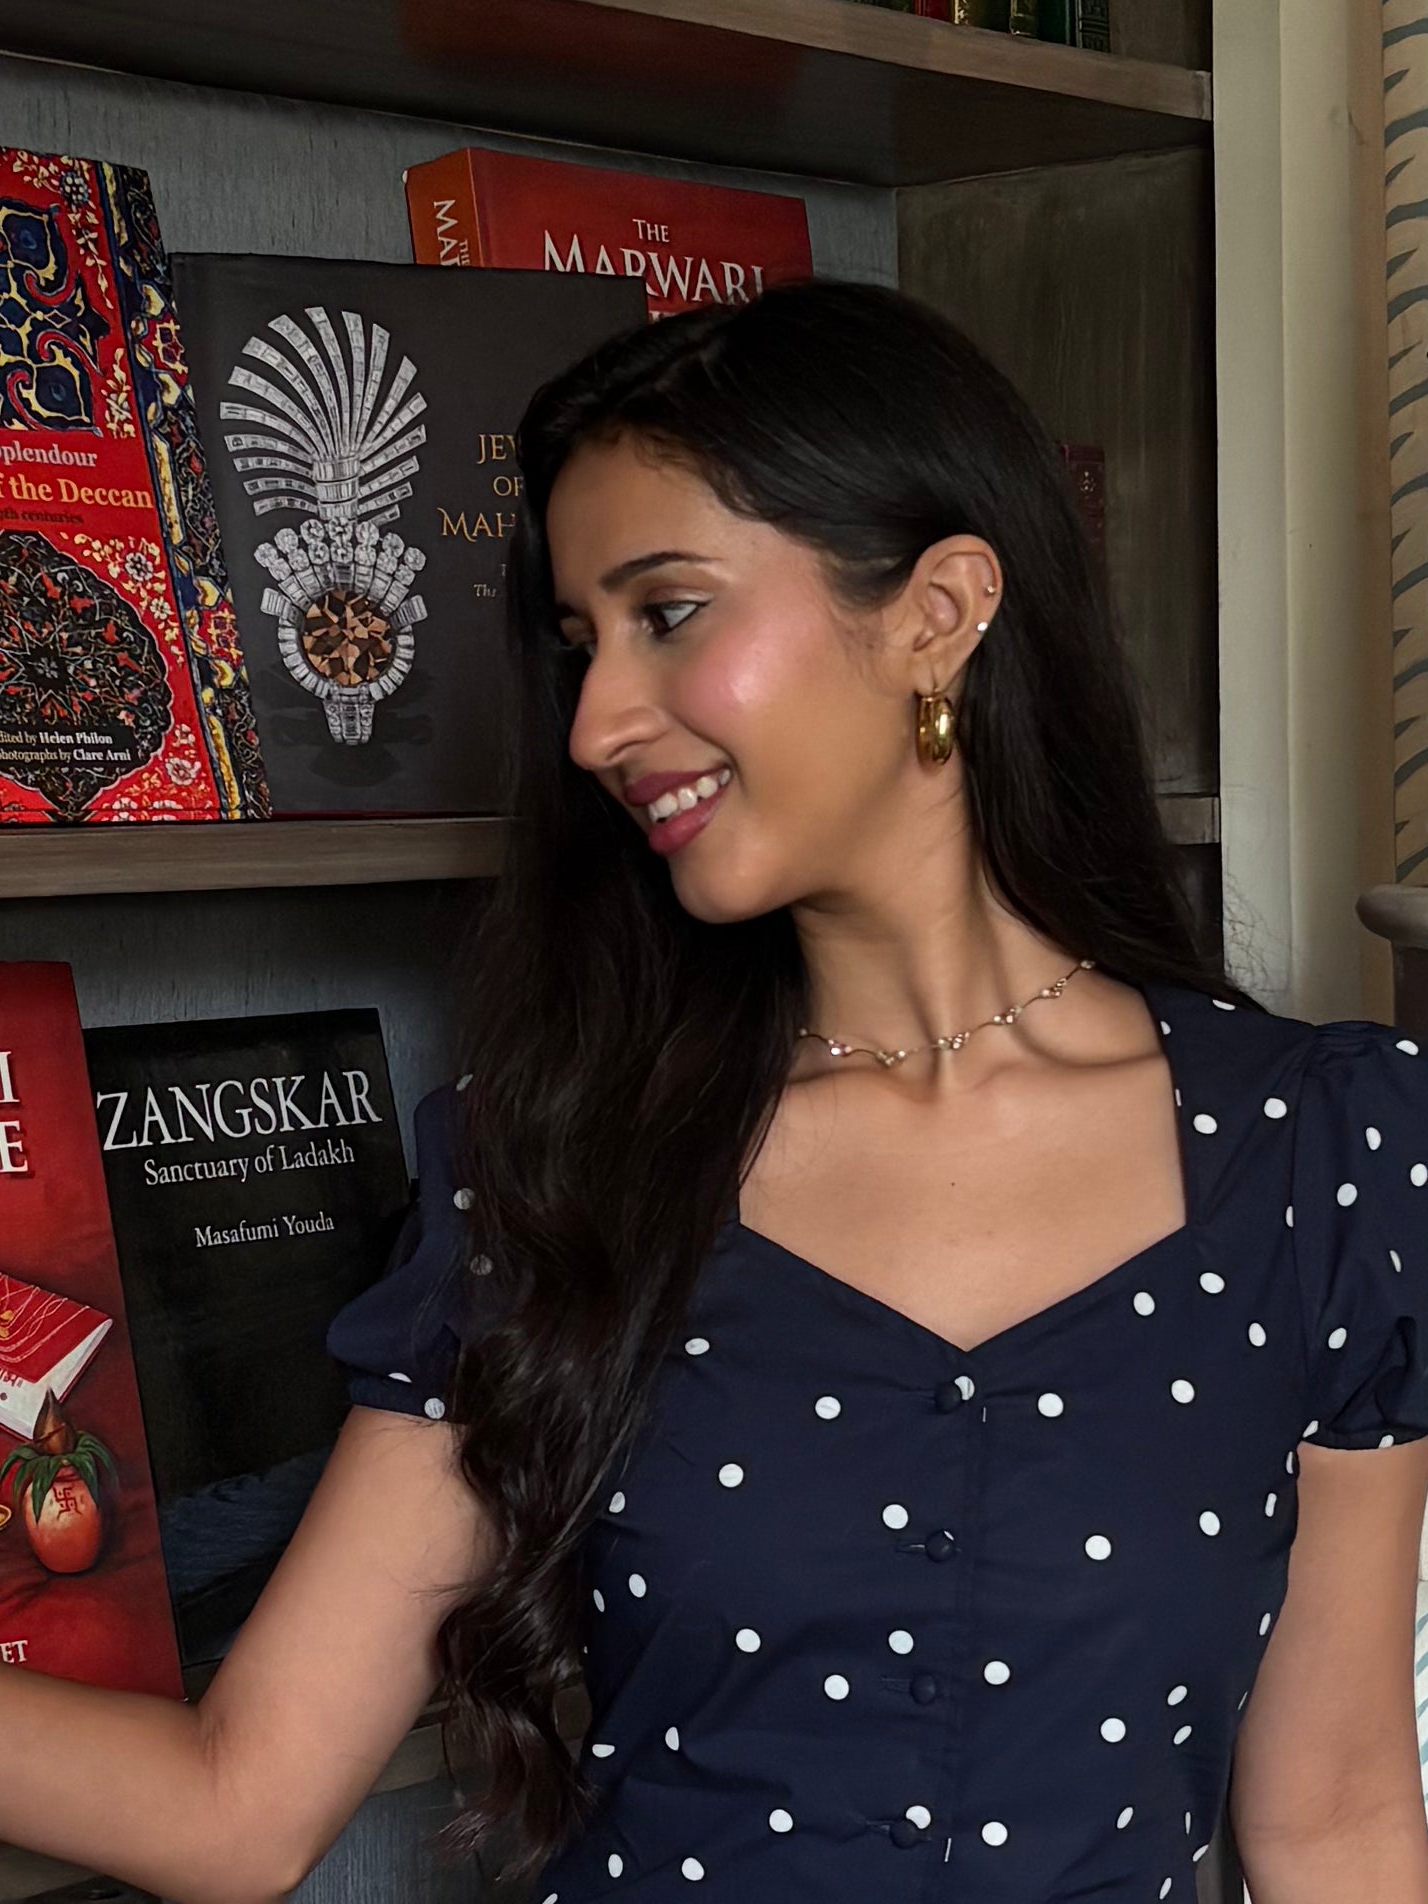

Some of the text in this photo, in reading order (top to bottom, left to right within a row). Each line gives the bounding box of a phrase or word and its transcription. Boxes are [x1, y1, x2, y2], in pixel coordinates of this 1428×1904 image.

[632, 218, 670, 244] THE
[10, 474, 53, 502] the
[56, 478, 154, 508] Deccan
[22, 509, 84, 524] centuries
[25, 731, 37, 746] by
[39, 731, 73, 744] Helen
[75, 732, 113, 745] Philon
[58, 749, 72, 763] by
[73, 749, 104, 761] Clare
[106, 749, 132, 761] Arni
[96, 1070, 382, 1151] ZANGSKAR
[143, 1138, 356, 1186] Sanctuary of Ladakh
[193, 1211, 336, 1248] Masafumi Youda
